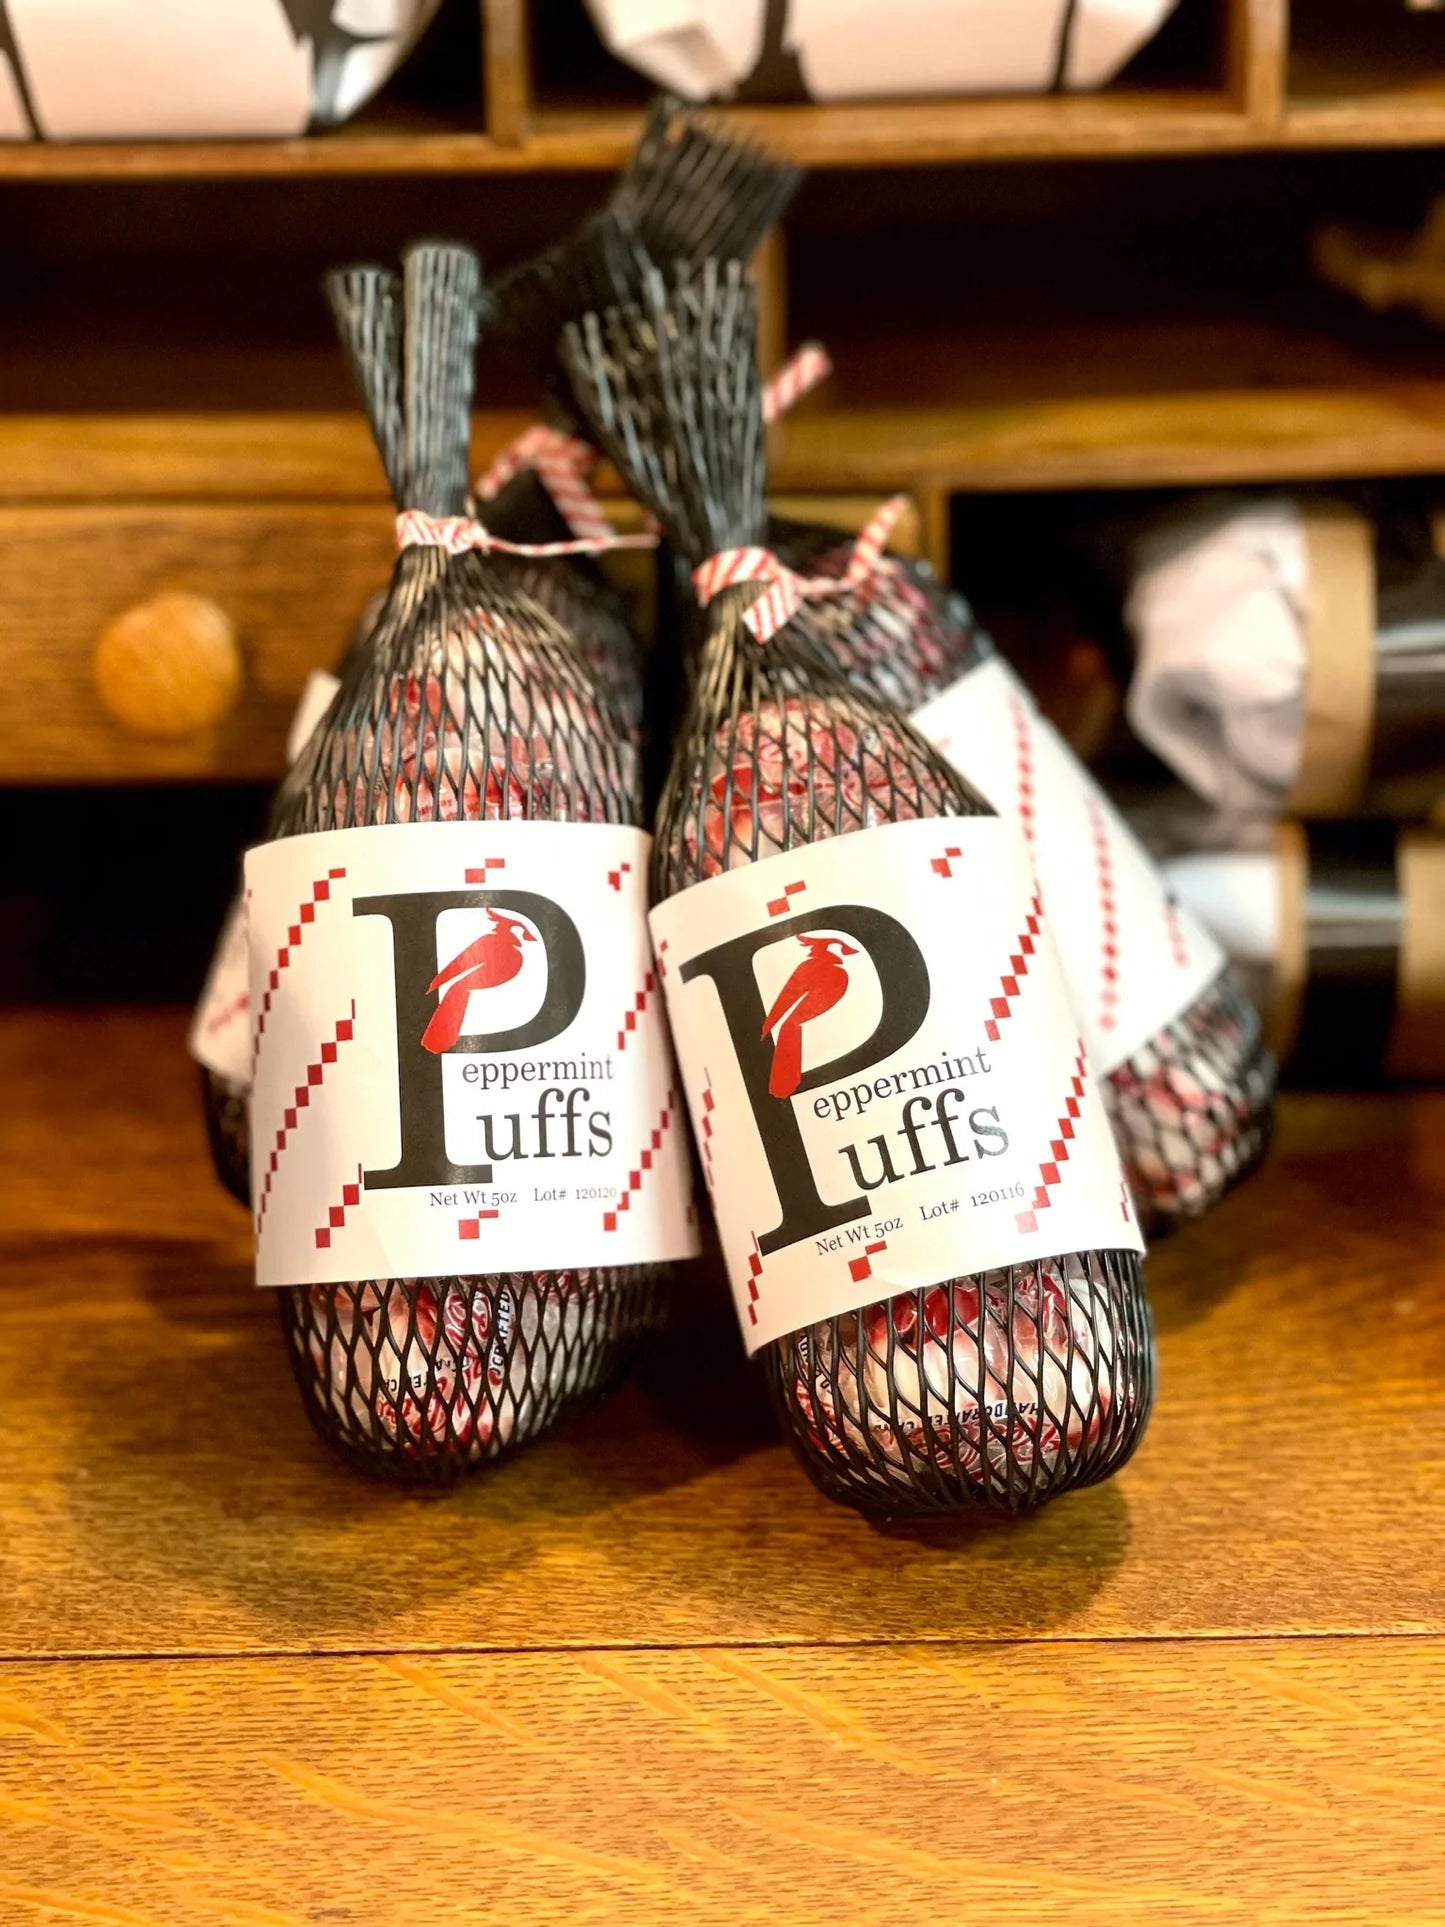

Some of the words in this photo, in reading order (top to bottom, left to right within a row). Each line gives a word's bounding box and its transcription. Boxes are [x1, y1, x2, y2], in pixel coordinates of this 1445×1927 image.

[461, 1052, 615, 1090] eppermint
[812, 1046, 992, 1122] eppermint
[475, 1087, 614, 1161] uffs
[838, 1087, 1010, 1191] uffs
[429, 1191, 458, 1207] Net
[463, 1189, 487, 1205] Wt
[491, 1192, 518, 1207] 5oz
[534, 1187, 567, 1202] Lot#
[575, 1186, 617, 1200] 120120
[815, 1234, 843, 1256] Net
[845, 1225, 872, 1245] Wt
[874, 1216, 904, 1239] 5oz
[919, 1198, 961, 1221] Lot#
[969, 1181, 1026, 1208] 120116
